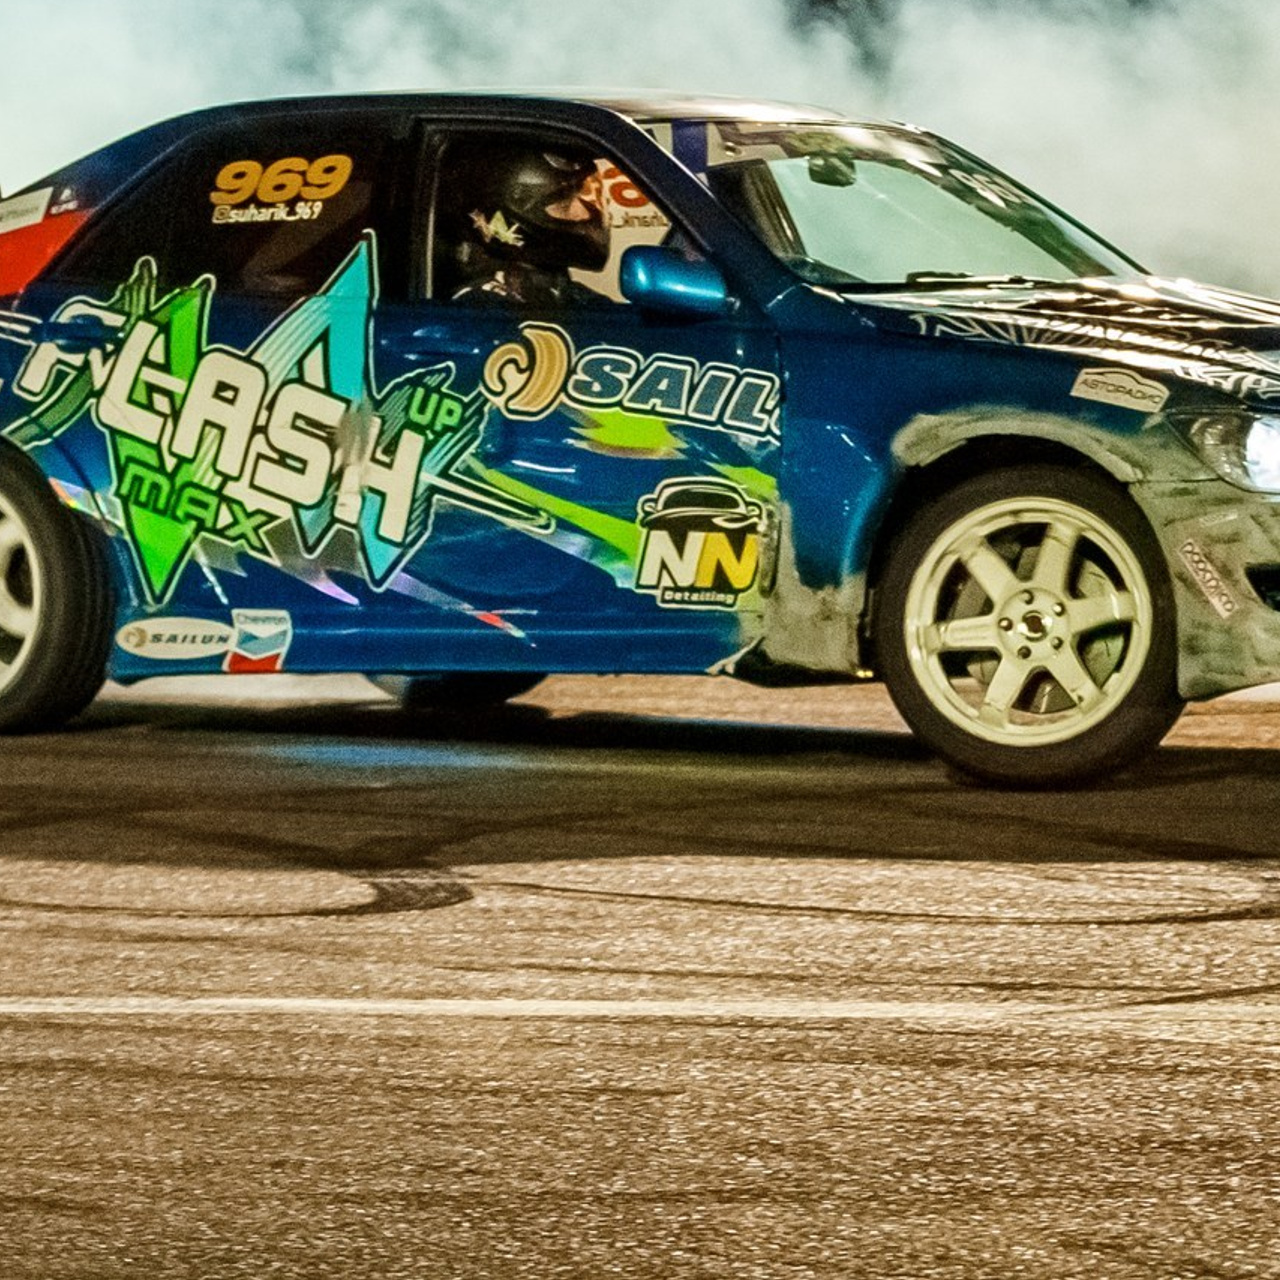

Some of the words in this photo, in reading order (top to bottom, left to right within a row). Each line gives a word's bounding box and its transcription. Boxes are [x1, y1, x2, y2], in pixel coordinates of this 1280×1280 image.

[209, 153, 354, 205] 969
[410, 393, 463, 429] UP
[564, 344, 782, 446] SAIL
[638, 529, 759, 589] NN
[663, 590, 736, 604] Detailing
[151, 632, 230, 644] SAILUN
